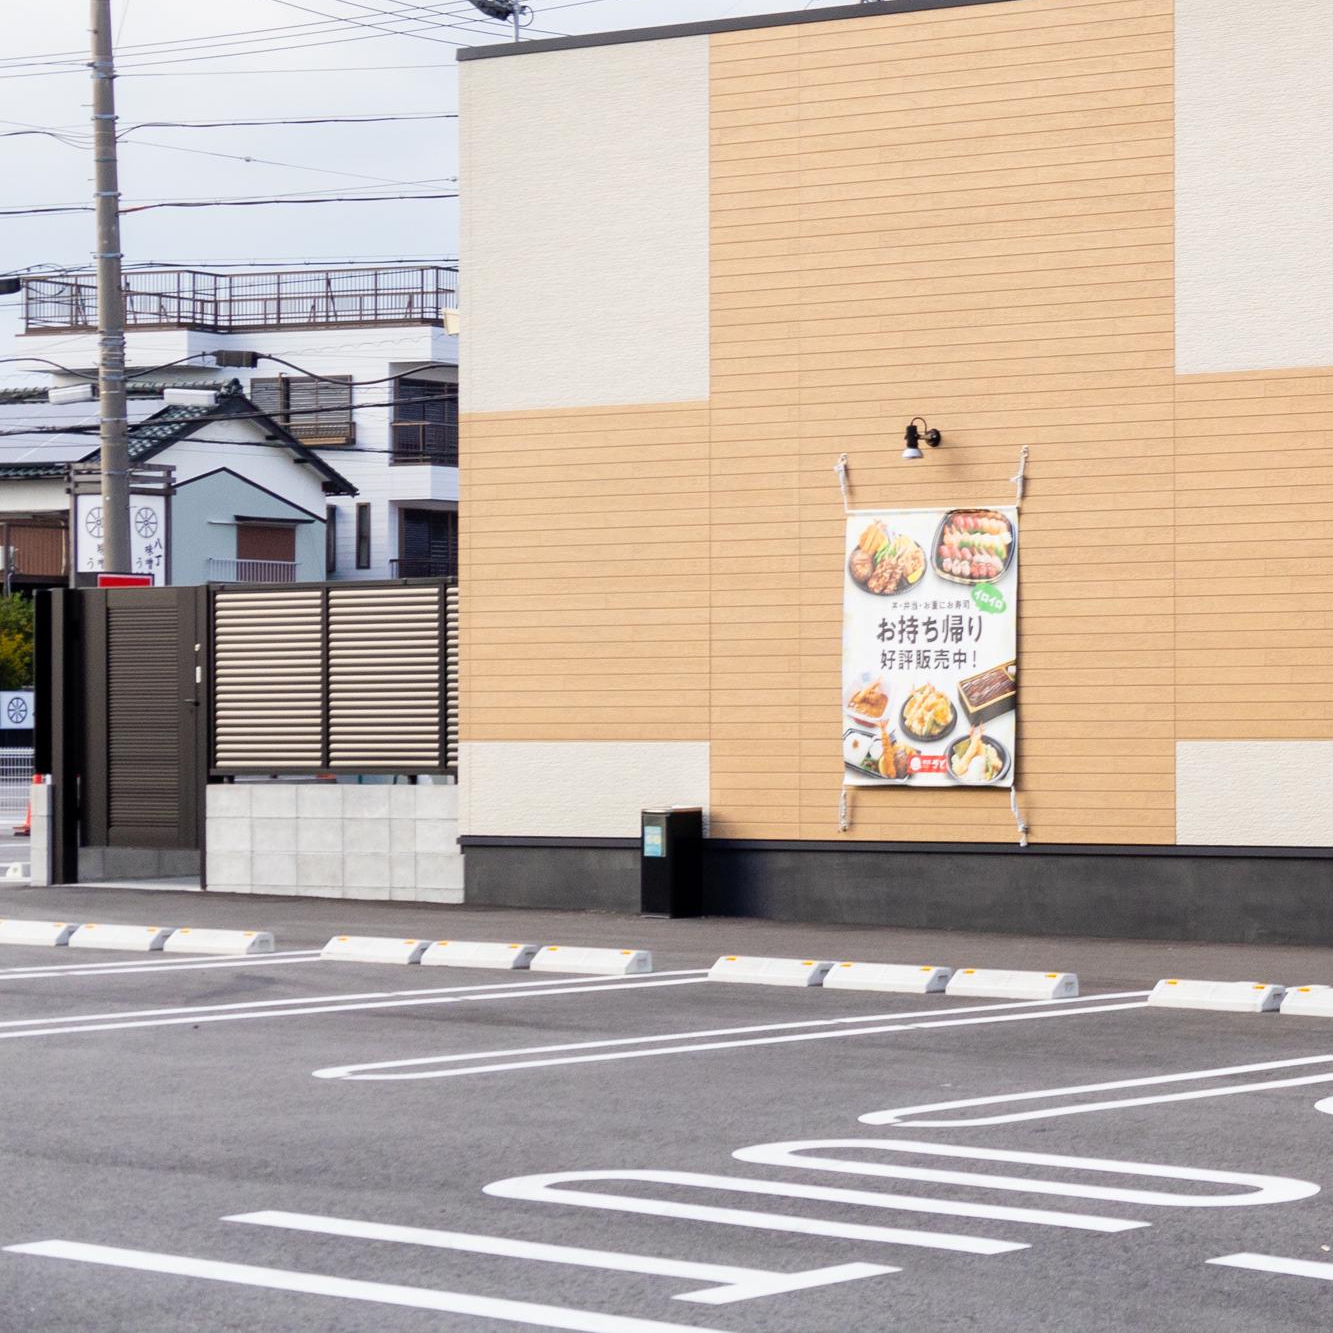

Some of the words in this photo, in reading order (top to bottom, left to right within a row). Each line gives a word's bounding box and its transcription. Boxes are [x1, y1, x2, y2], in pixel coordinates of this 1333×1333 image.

[876, 614, 983, 644] お持ち帰り
